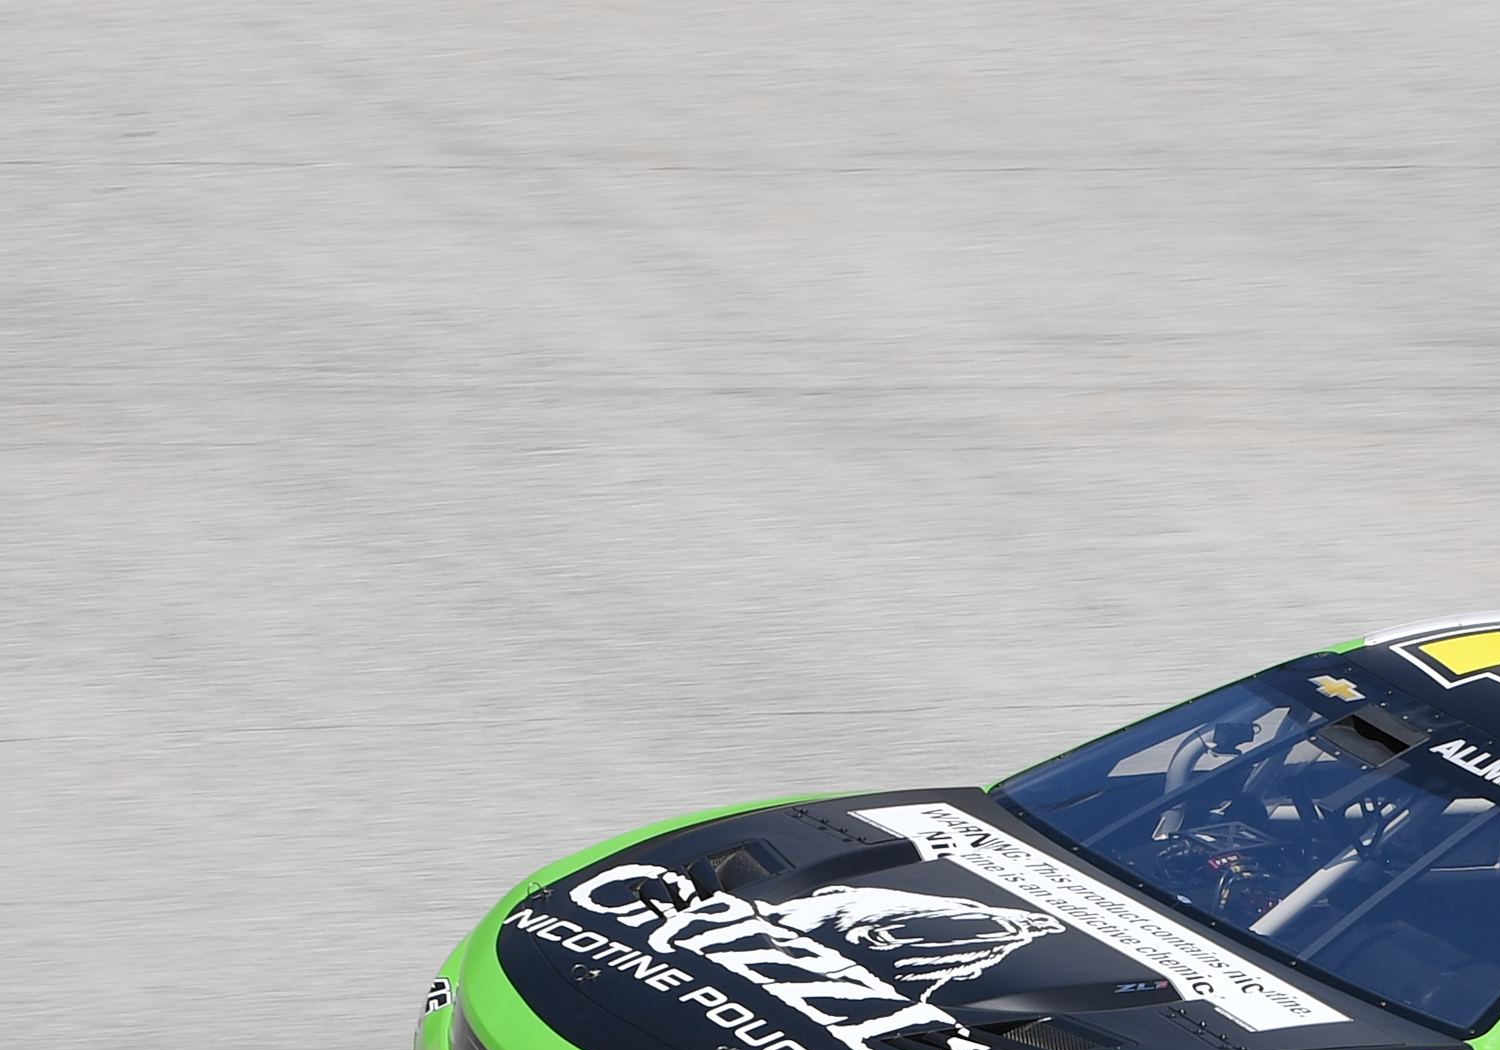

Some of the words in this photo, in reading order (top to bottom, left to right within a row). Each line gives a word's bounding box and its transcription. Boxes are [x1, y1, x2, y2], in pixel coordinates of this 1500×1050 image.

[917, 831, 1005, 872] Nitine
[998, 872, 1025, 884] is
[1018, 883, 1051, 898] an
[1045, 896, 1142, 946] addictive
[920, 808, 1033, 862] WARNING:
[1025, 861, 1072, 884] This
[1058, 881, 1152, 926] product
[1140, 924, 1230, 969] contains
[1222, 969, 1312, 1018] nictine.
[502, 908, 693, 992] NICOTINE
